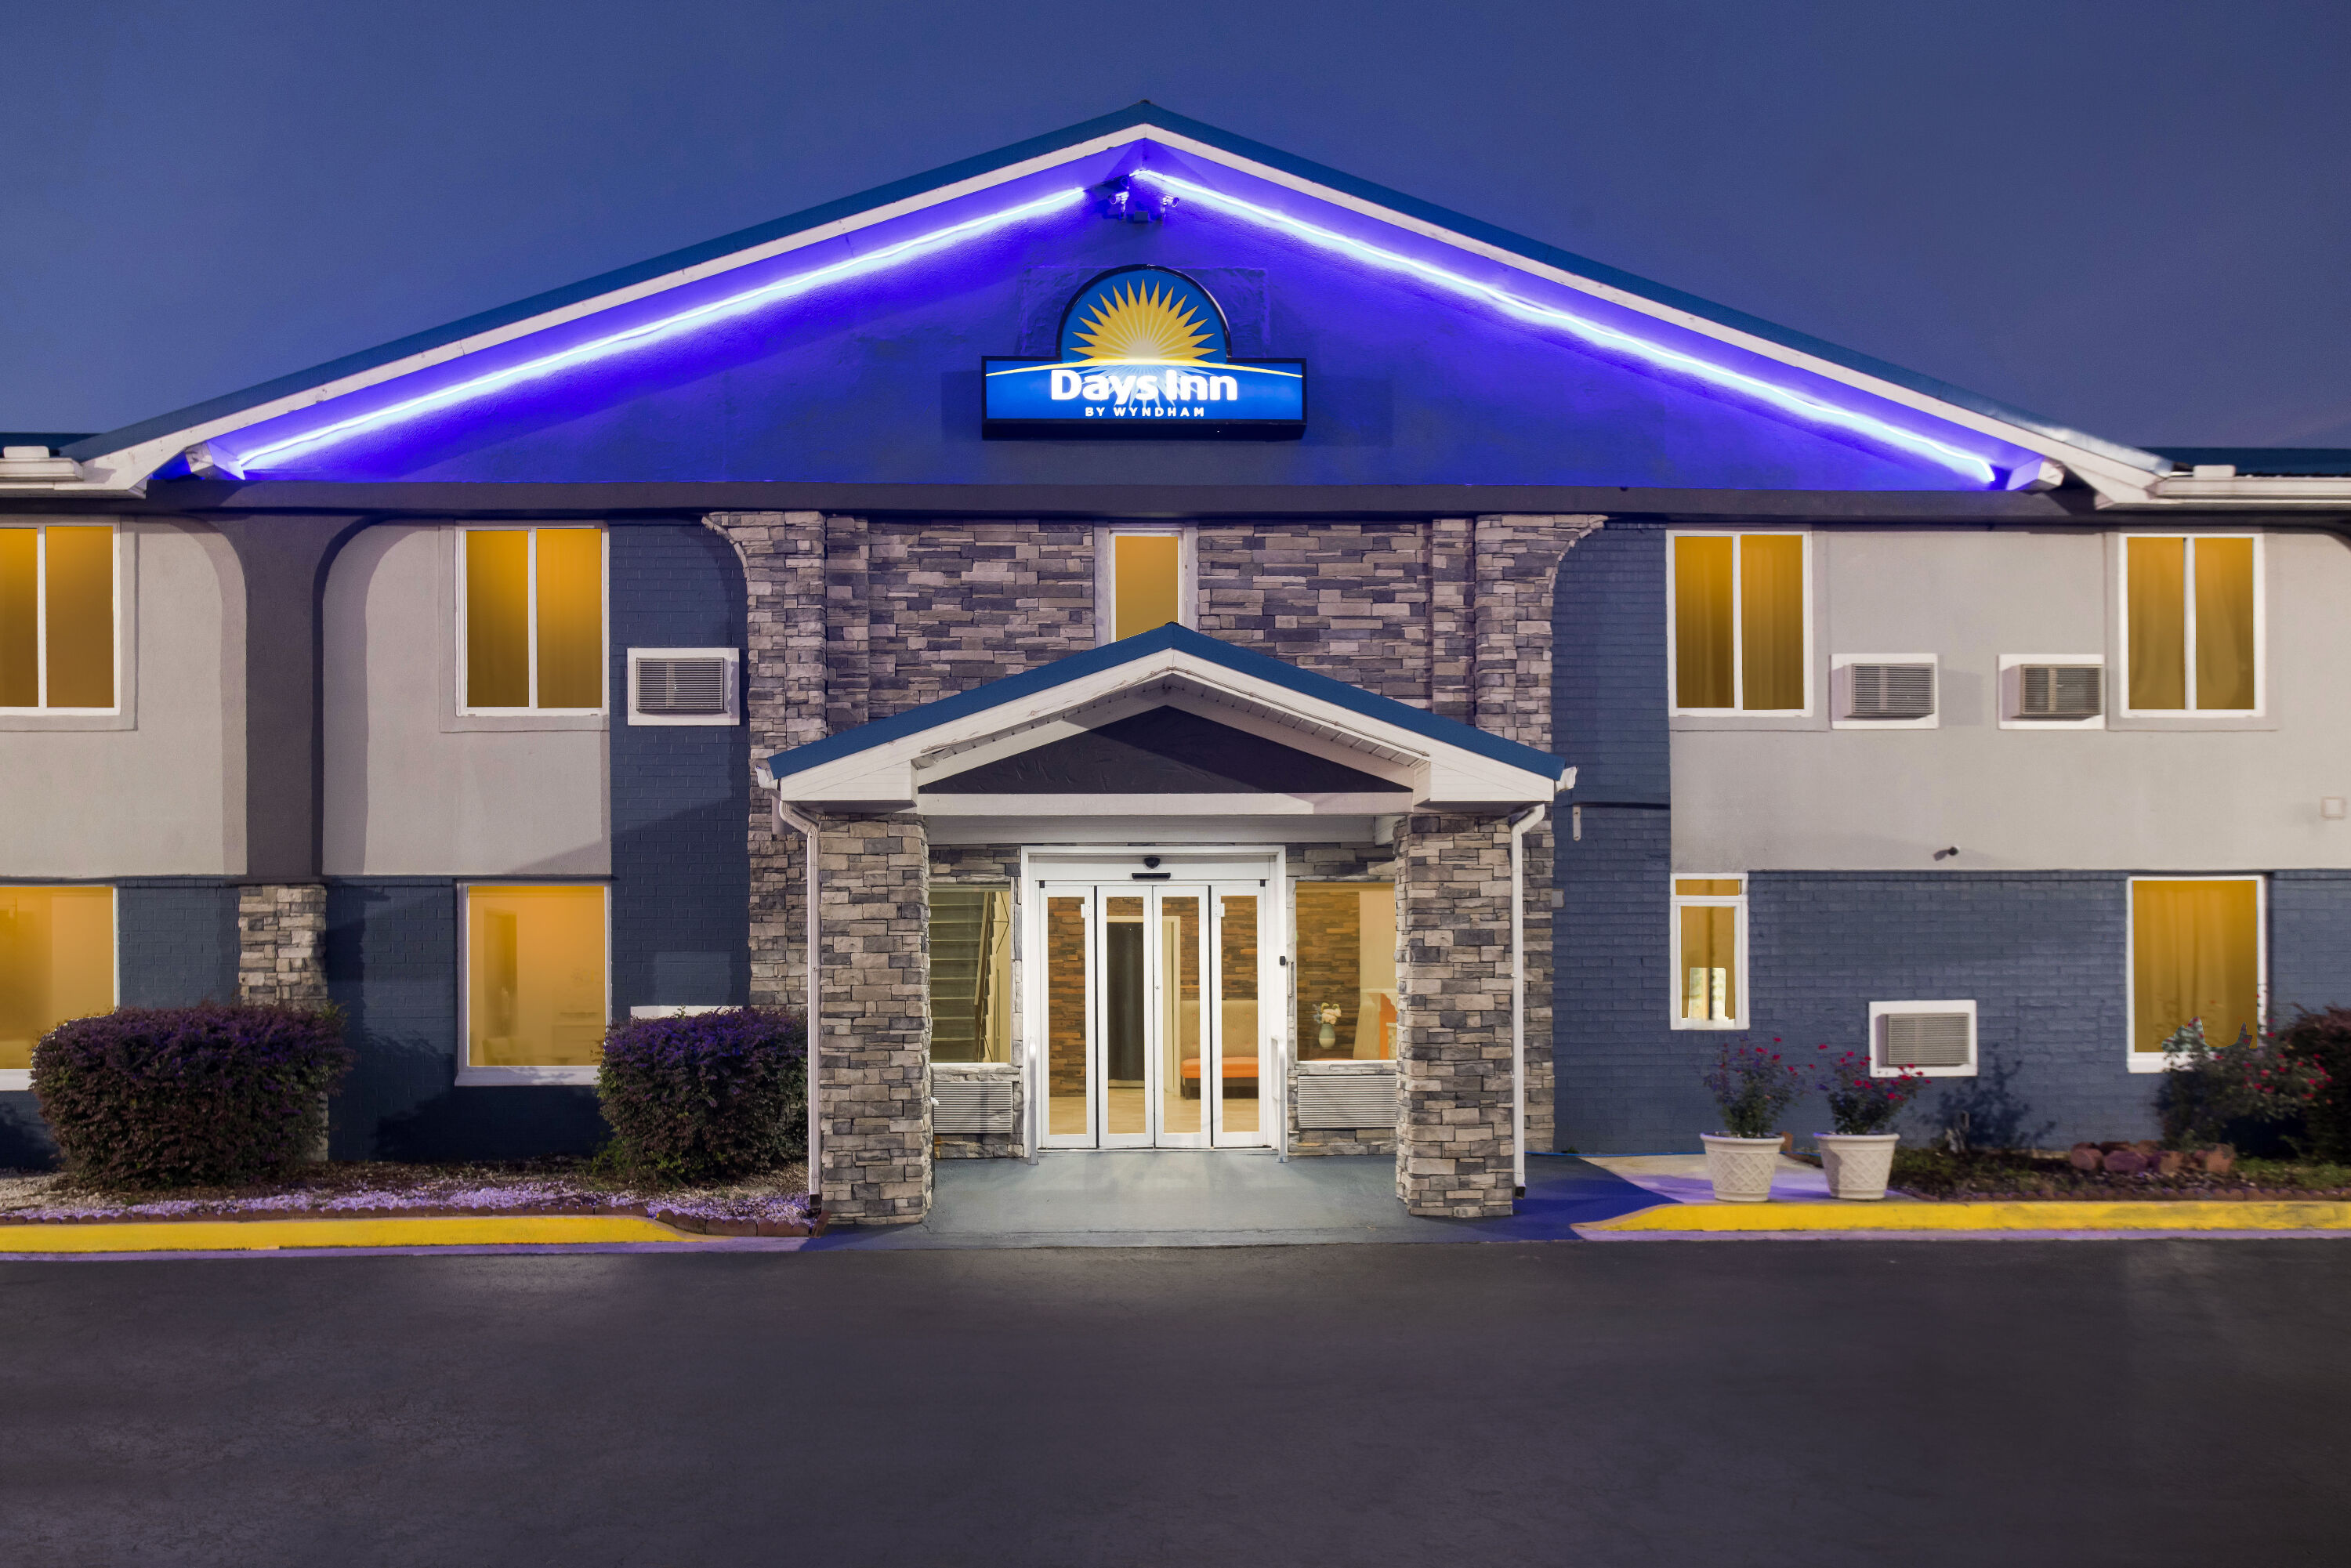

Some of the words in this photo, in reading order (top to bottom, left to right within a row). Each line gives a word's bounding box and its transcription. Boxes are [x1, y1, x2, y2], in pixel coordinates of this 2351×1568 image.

[1051, 369, 1157, 404] Days
[1165, 370, 1237, 401] Inn
[1085, 407, 1105, 417] BY
[1114, 407, 1204, 417] WYNDHAM
